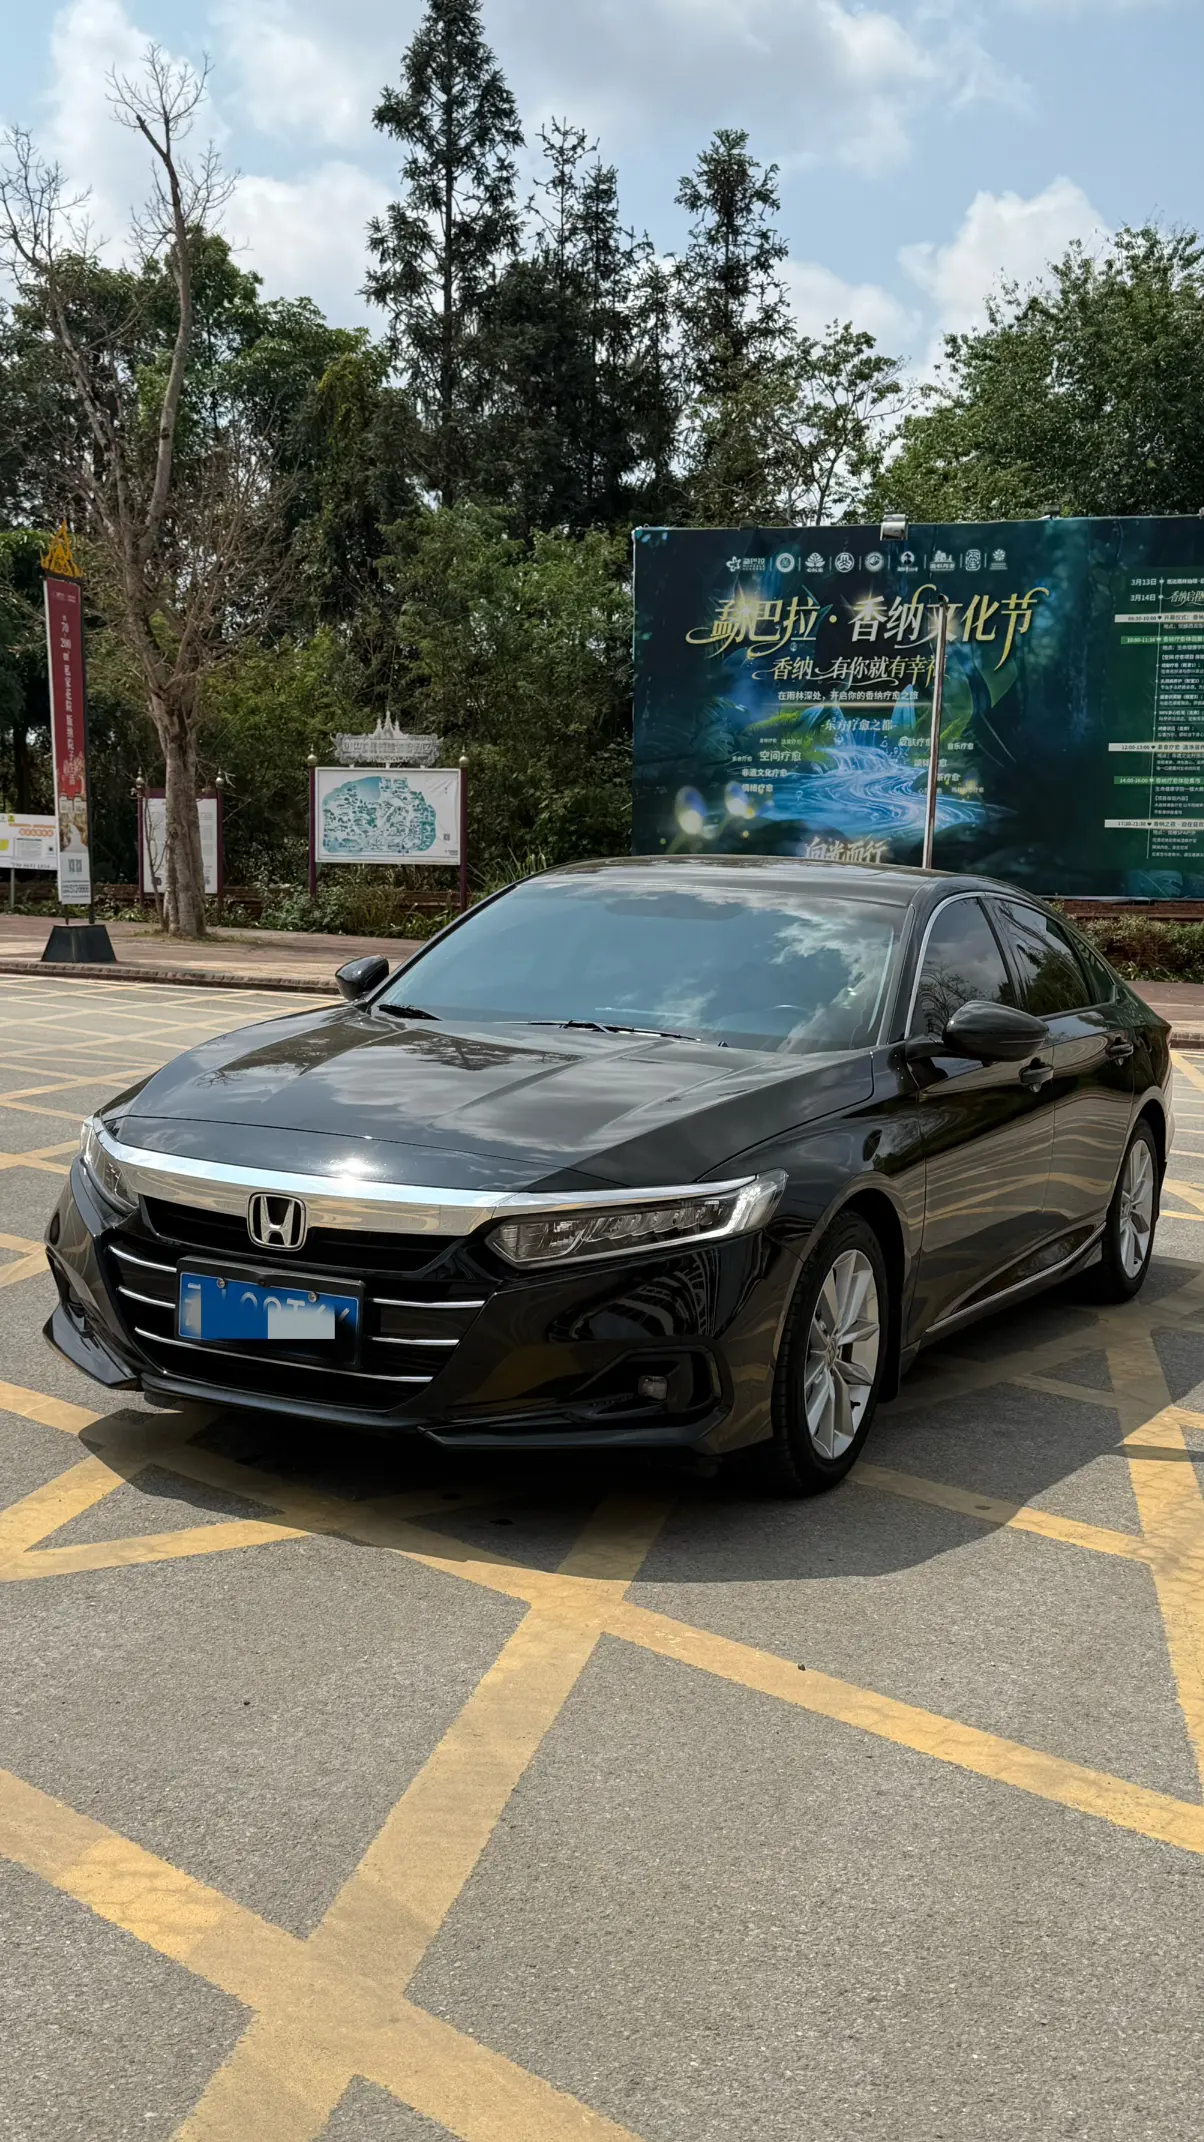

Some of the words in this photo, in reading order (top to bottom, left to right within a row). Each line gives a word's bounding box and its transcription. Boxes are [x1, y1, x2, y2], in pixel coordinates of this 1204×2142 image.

[1130, 578, 1157, 586] 3月13日
[1130, 594, 1156, 602] 3月14日
[777, 690, 919, 702] 在雨林深处，开启你的香纳疗愈之旅
[759, 750, 802, 762] 空间疗愈
